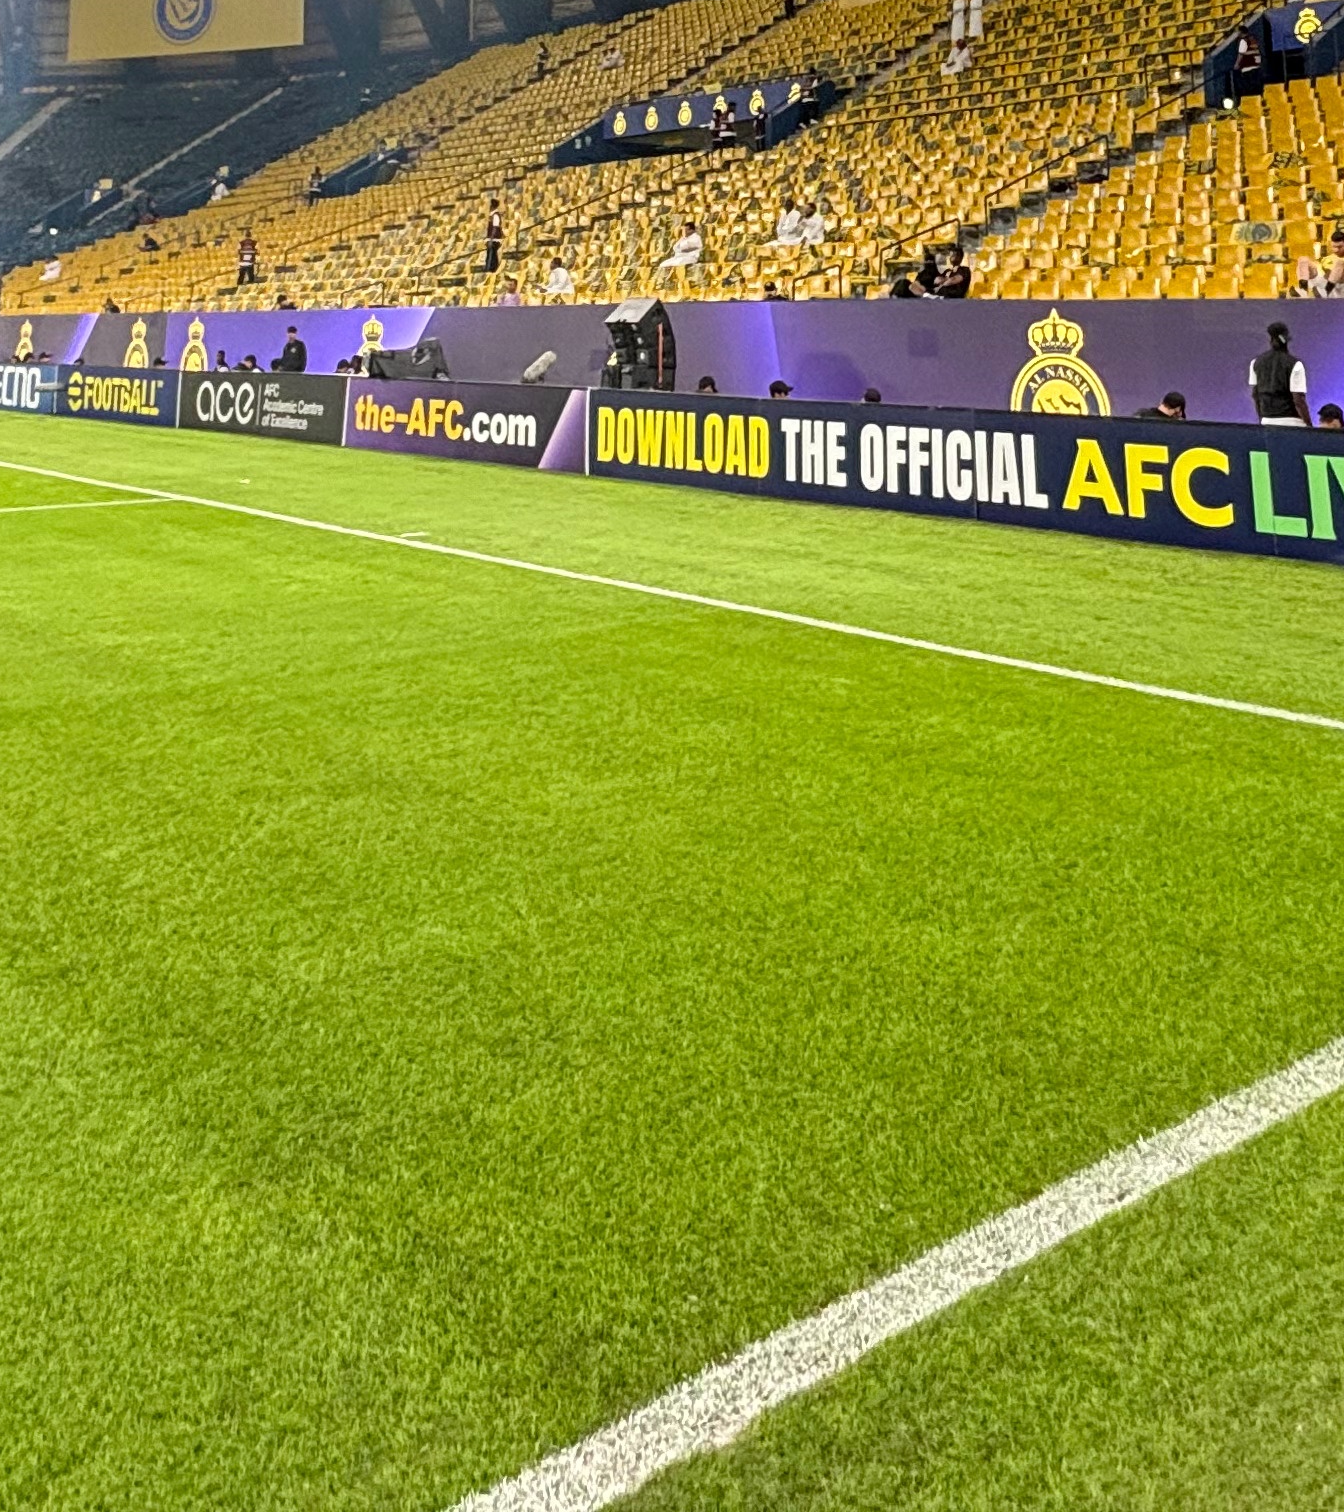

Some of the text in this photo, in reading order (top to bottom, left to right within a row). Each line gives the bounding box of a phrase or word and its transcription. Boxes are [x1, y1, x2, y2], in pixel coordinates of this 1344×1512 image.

[196, 380, 255, 425] ace
[264, 383, 280, 398] AFC
[1028, 366, 1090, 398] AL NASSR
[355, 395, 537, 447] the-AFC.com
[597, 406, 770, 479] DOWNLOAD
[781, 418, 847, 488] THE
[860, 424, 1049, 509] OFFICIAL
[1062, 438, 1235, 529] AFC
